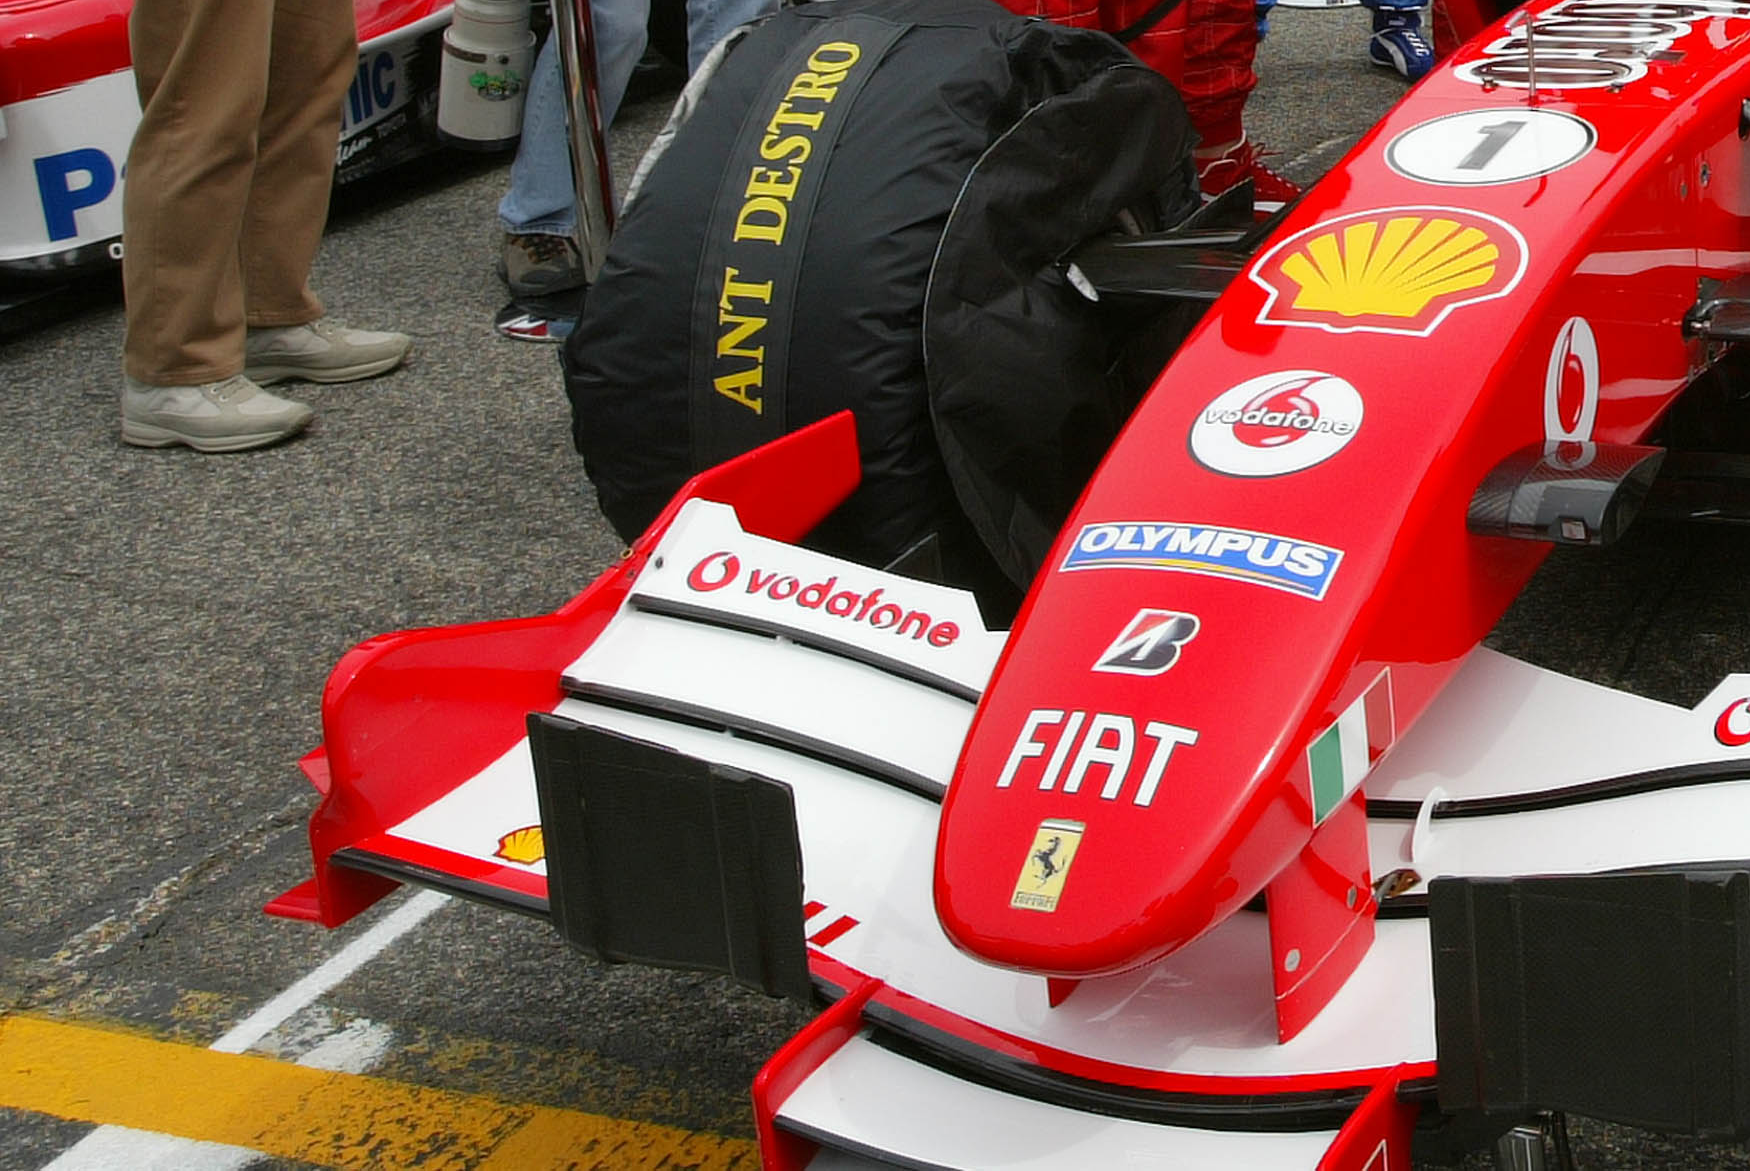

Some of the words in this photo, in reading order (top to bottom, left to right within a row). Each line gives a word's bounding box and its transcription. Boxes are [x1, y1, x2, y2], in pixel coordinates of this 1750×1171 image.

[733, 41, 862, 246] DESTRO
[1455, 120, 1528, 171] 1
[713, 266, 773, 415] ANT
[1203, 404, 1354, 437] vodafone
[1079, 524, 1331, 579] OLYMPUS
[746, 570, 961, 648] vodafone
[996, 708, 1199, 809] FIAT
[1013, 890, 1057, 910] Ferrari
